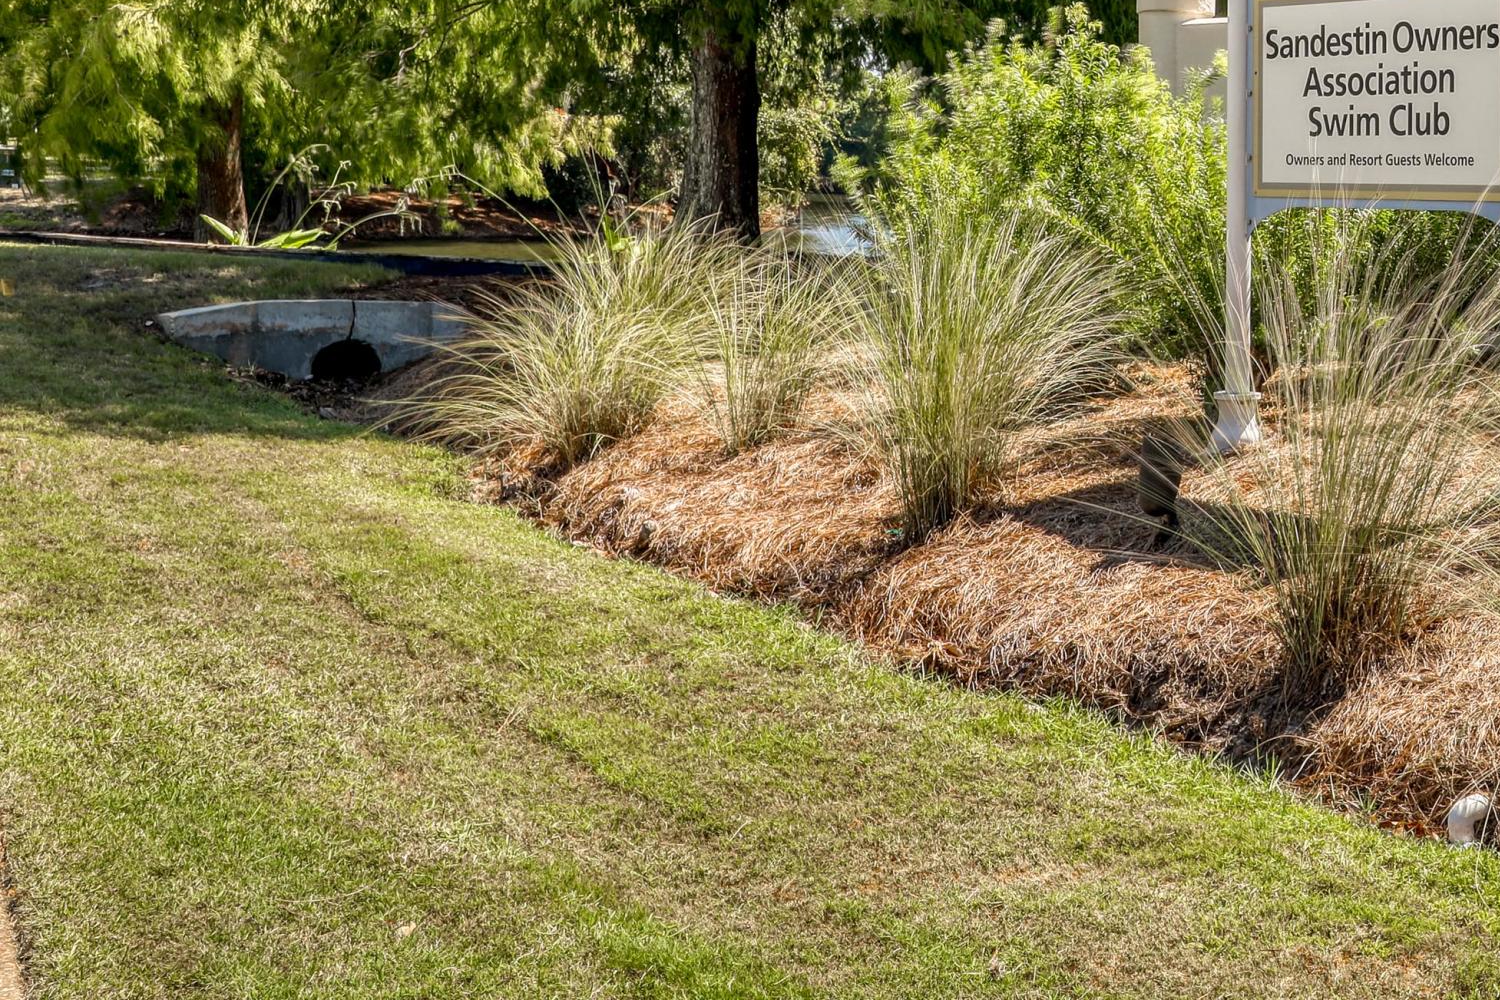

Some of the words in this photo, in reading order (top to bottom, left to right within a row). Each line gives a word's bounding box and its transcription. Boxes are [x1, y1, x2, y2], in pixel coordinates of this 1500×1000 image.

[1265, 22, 1387, 59] Sandestin
[1392, 21, 1500, 52] Owners
[1302, 61, 1455, 97] Association
[1308, 105, 1380, 137] Swim
[1389, 102, 1450, 136] Club
[1285, 154, 1324, 166] Owners
[1327, 153, 1346, 166] and
[1349, 153, 1383, 166] Resort
[1385, 153, 1421, 166] Guests
[1424, 152, 1474, 166] Welcome
